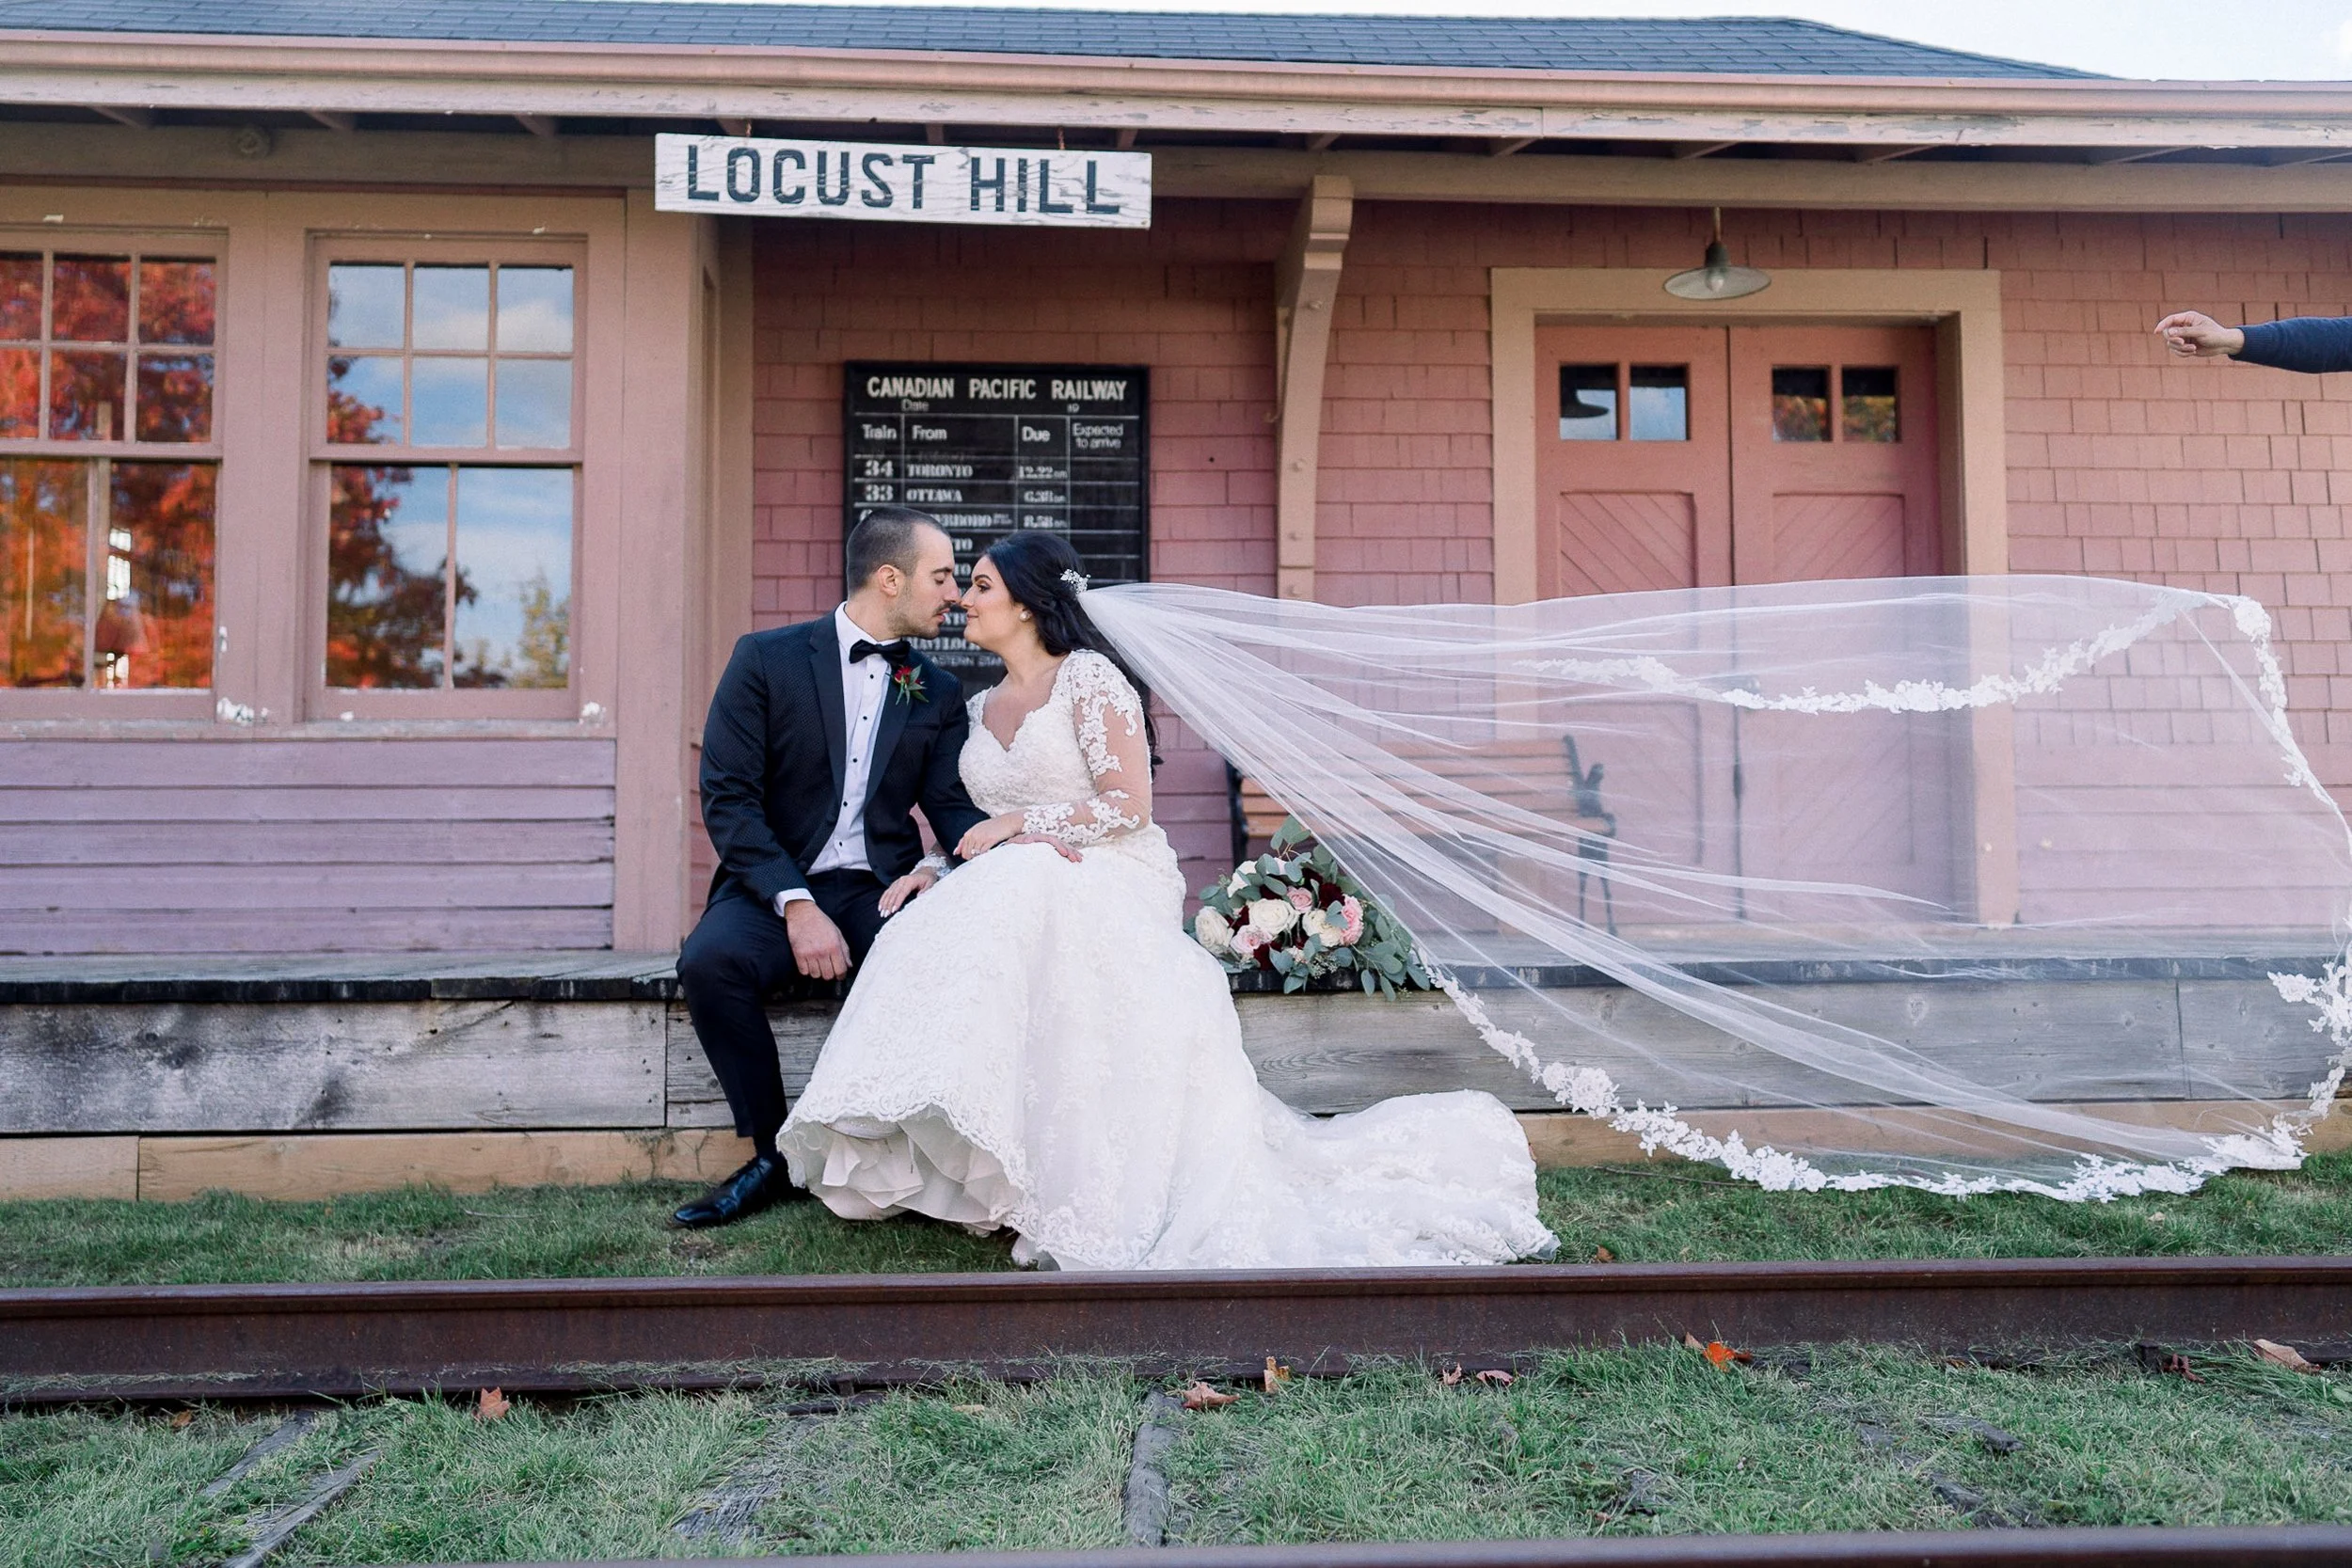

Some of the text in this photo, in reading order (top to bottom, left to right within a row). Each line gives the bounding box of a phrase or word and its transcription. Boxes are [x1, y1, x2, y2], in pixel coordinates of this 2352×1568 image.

[687, 144, 1120, 214] LOCUST HILL
[866, 376, 1127, 401] CANADIAN PACIFIC RAILWAY
[900, 399, 930, 412] Date
[862, 424, 898, 440] Train
[912, 425, 947, 440] From
[1022, 426, 1051, 442] Due
[1073, 423, 1124, 437] Expected
[1076, 437, 1089, 449] to
[864, 460, 894, 478] 34
[906, 464, 974, 478] TORONTO
[865, 484, 894, 502] 33
[906, 488, 963, 502] OTTAWA
